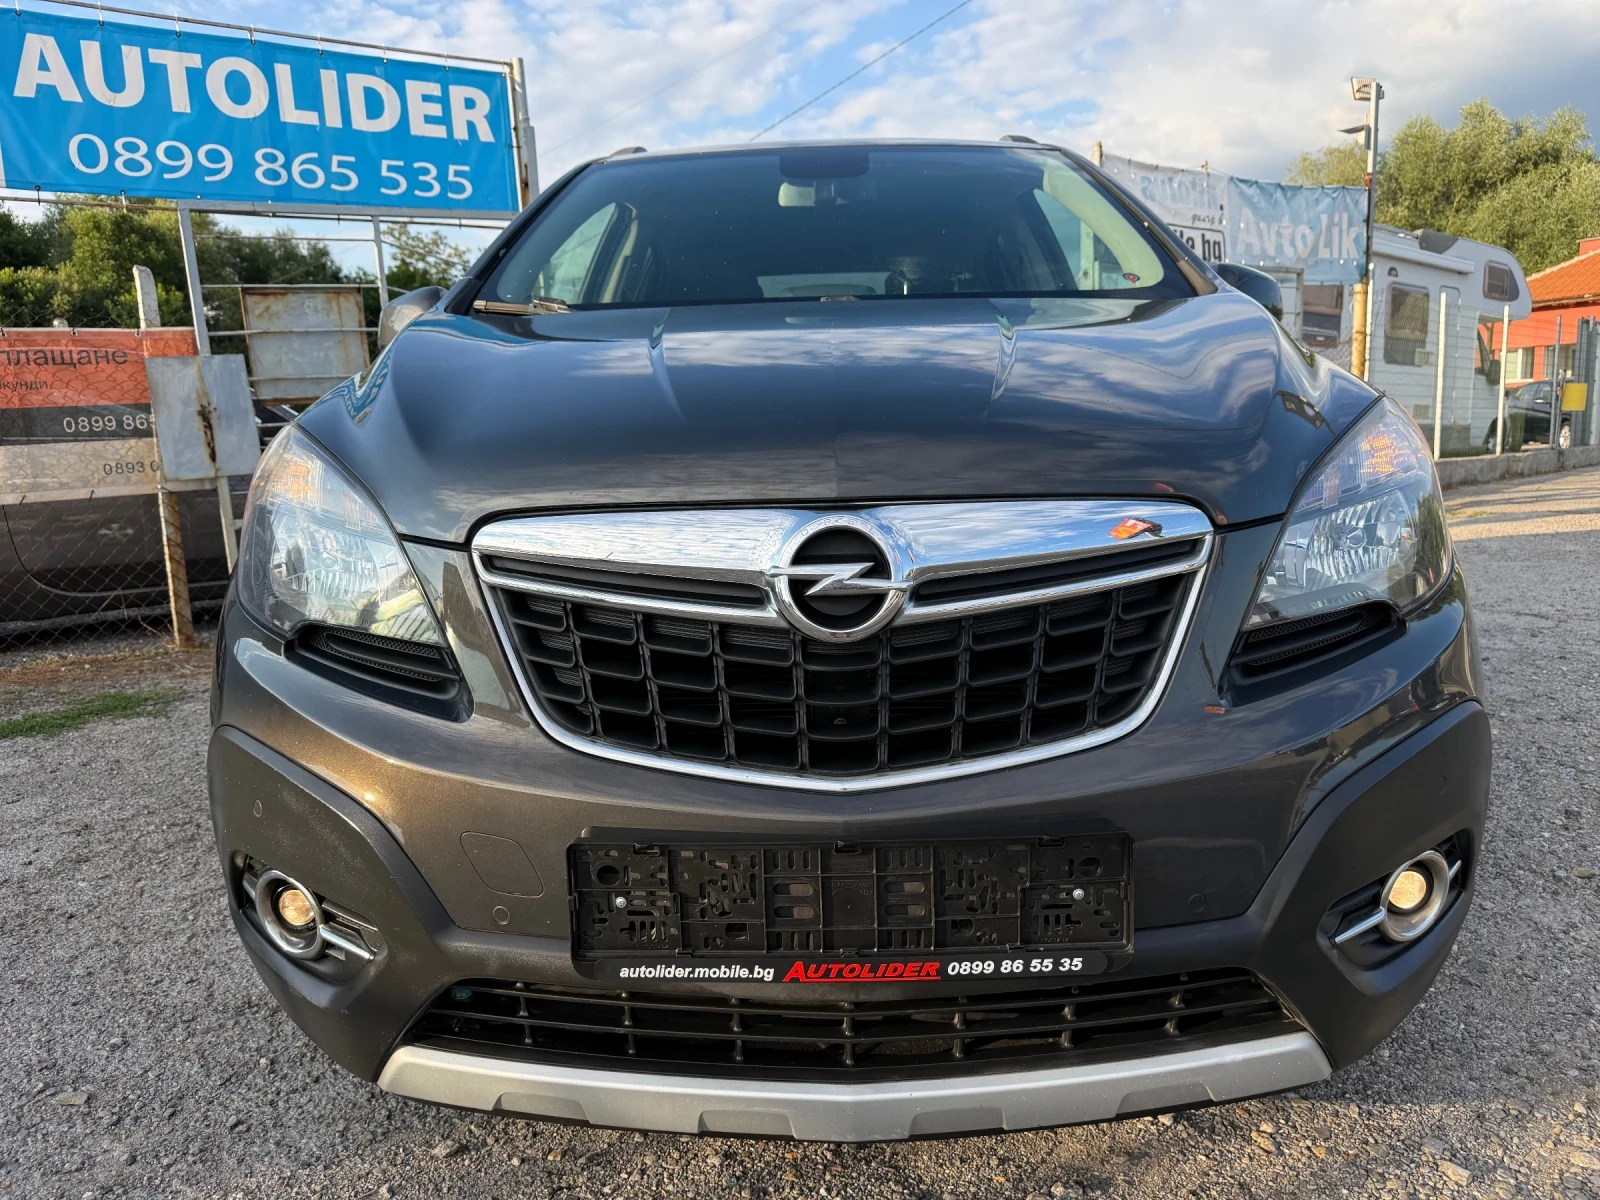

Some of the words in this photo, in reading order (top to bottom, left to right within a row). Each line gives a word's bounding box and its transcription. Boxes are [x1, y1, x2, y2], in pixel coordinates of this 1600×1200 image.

[13, 32, 495, 143] AUTOLIDER
[68, 133, 233, 182] 0899
[254, 147, 359, 192] 865
[379, 160, 473, 200] 535
[63, 415, 117, 433] 0899
[103, 461, 146, 476] 0893
[620, 964, 775, 981] autolider.mobile.bg
[783, 961, 941, 982] AUTOLIDER
[947, 960, 995, 976] 0899
[1000, 959, 1024, 974] 86
[1029, 958, 1053, 973] 55
[1058, 957, 1083, 972] 35
